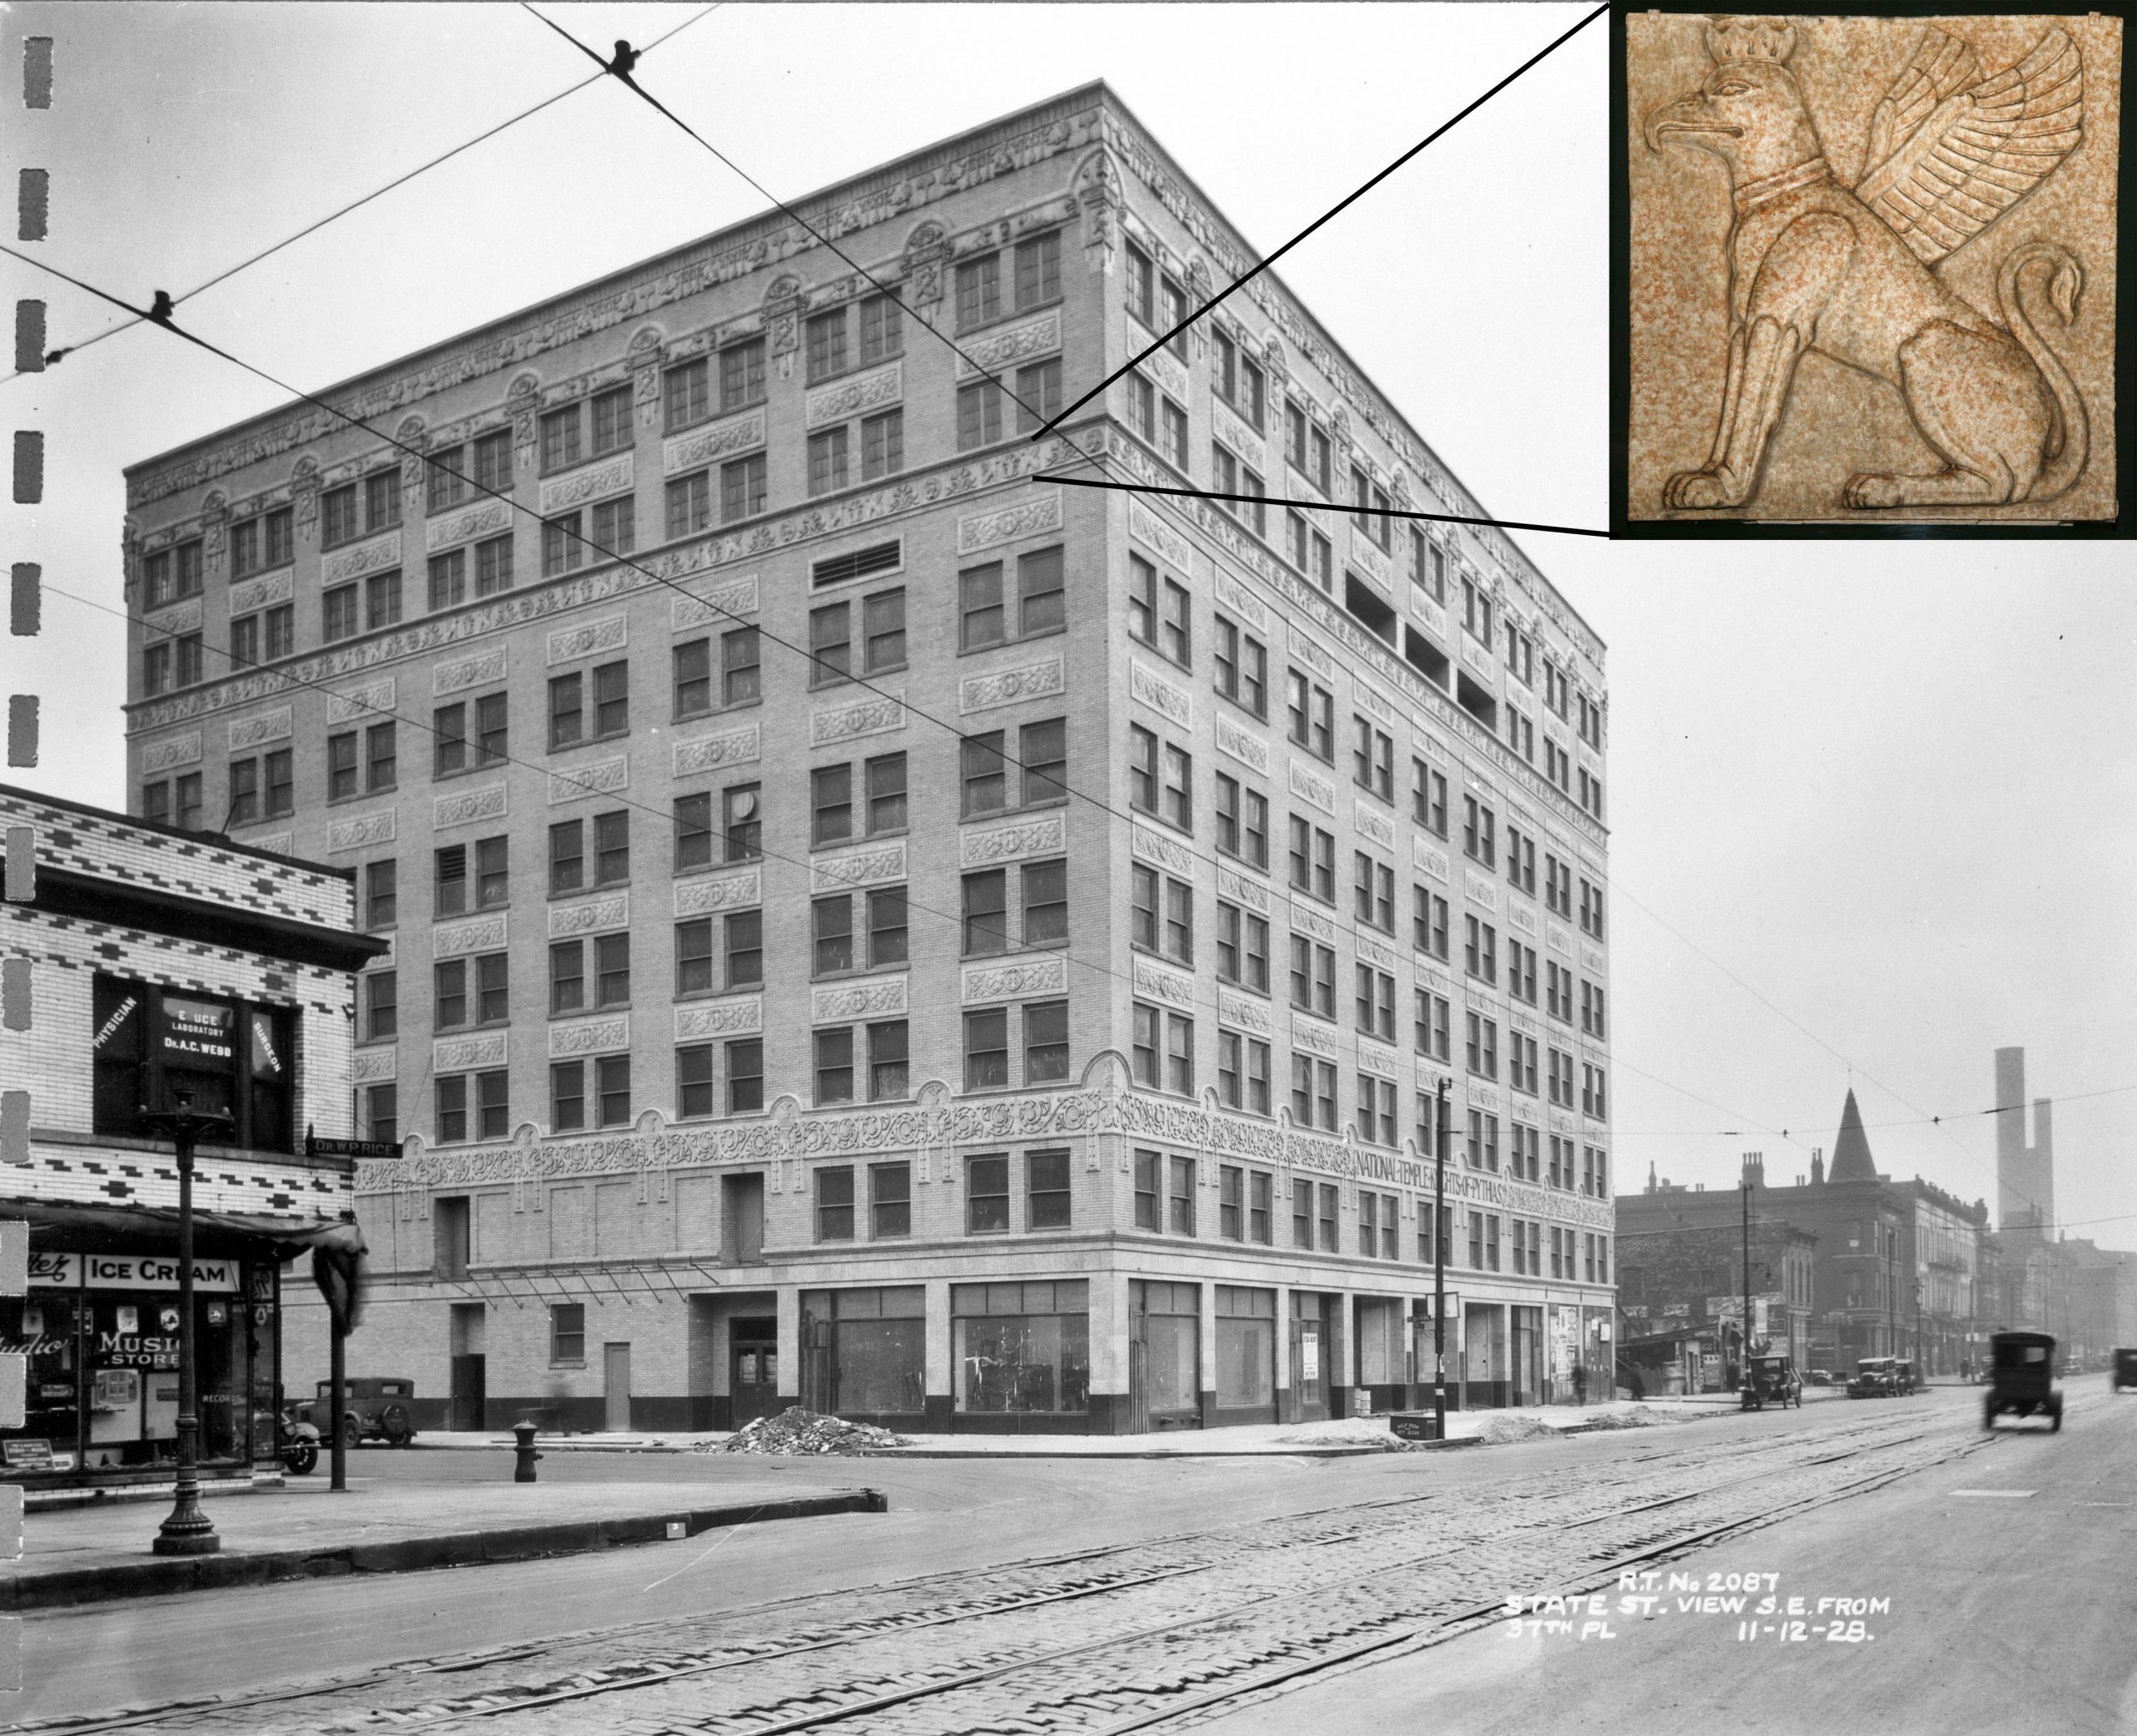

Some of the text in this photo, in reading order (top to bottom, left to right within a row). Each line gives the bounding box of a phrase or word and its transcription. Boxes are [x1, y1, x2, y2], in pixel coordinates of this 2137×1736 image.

[93, 997, 138, 1049] PHYSICIAN
[172, 1022, 224, 1037] LABORATORY
[200, 1043, 231, 1057] WEBB
[254, 1022, 281, 1072] SURGEON
[361, 1143, 395, 1156] RICE
[1356, 1150, 1399, 1183] NATIONAL
[1472, 1178, 1503, 1204] PYTHIAS
[91, 1259, 133, 1279] ICE
[111, 1354, 180, 1365] STORE
[202, 1395, 242, 1404] RECORDS
